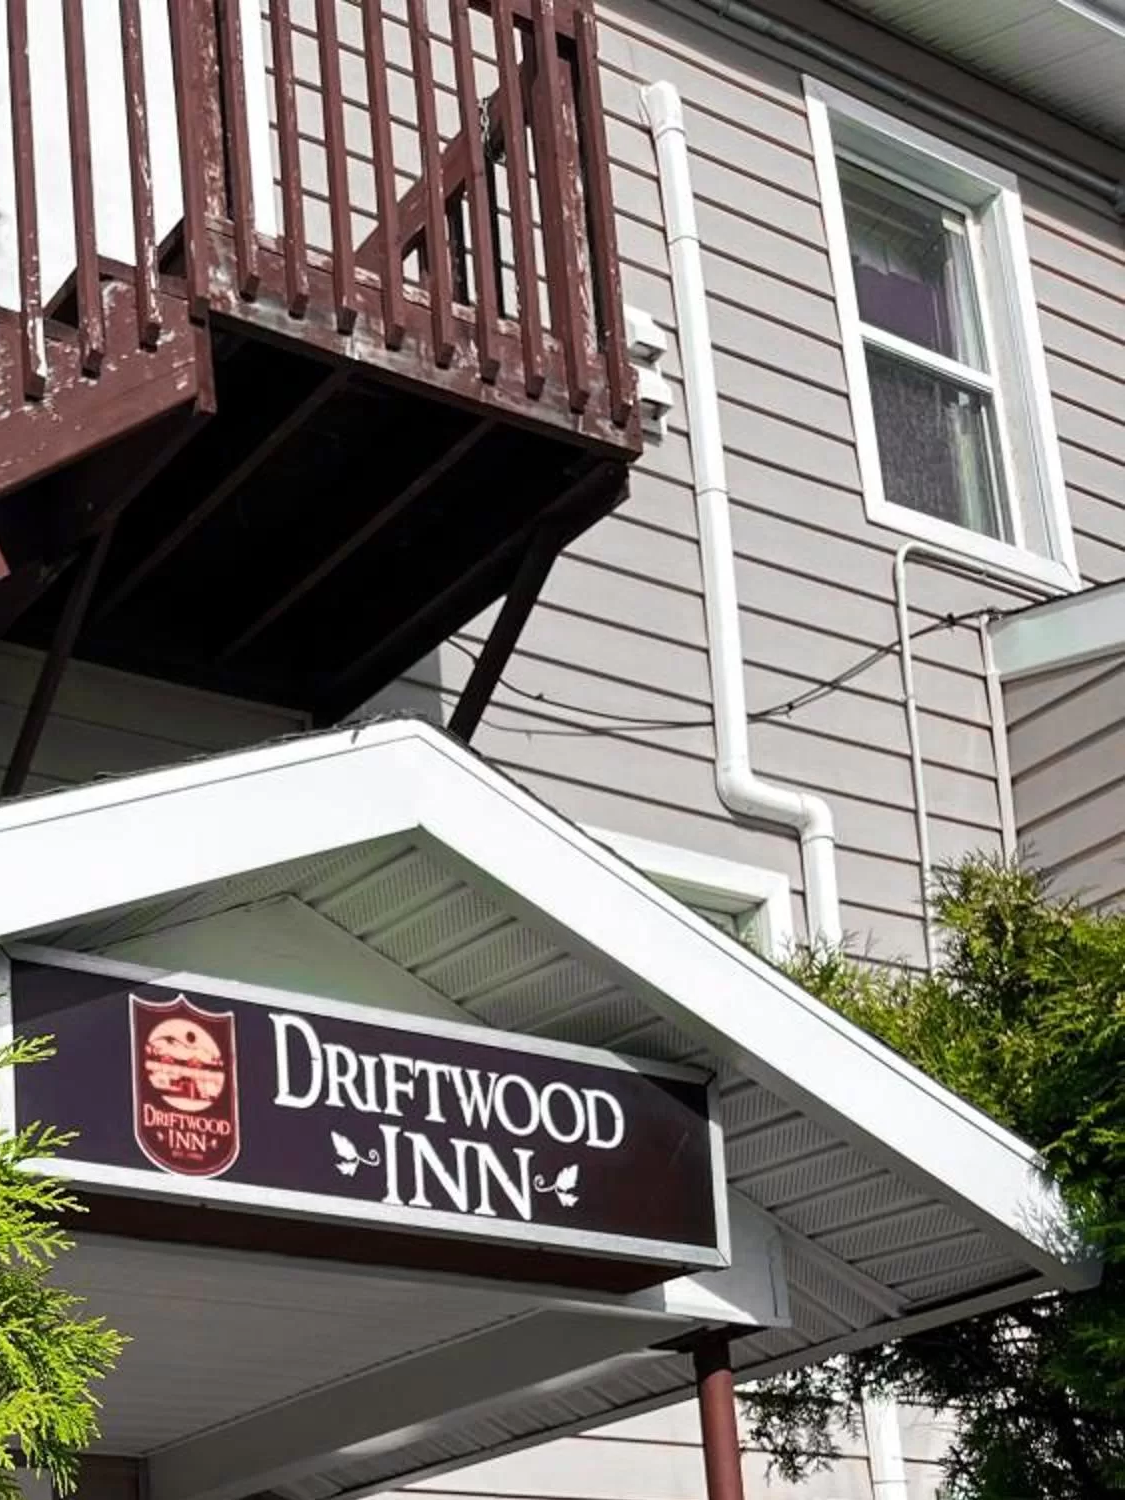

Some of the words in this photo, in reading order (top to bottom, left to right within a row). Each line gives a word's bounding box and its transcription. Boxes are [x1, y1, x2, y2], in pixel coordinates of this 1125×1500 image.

[268, 1012, 625, 1149] DRIFTWOOD
[143, 1103, 231, 1136] DRIFTWOOD
[168, 1128, 207, 1153] INN
[378, 1123, 534, 1221] INN
